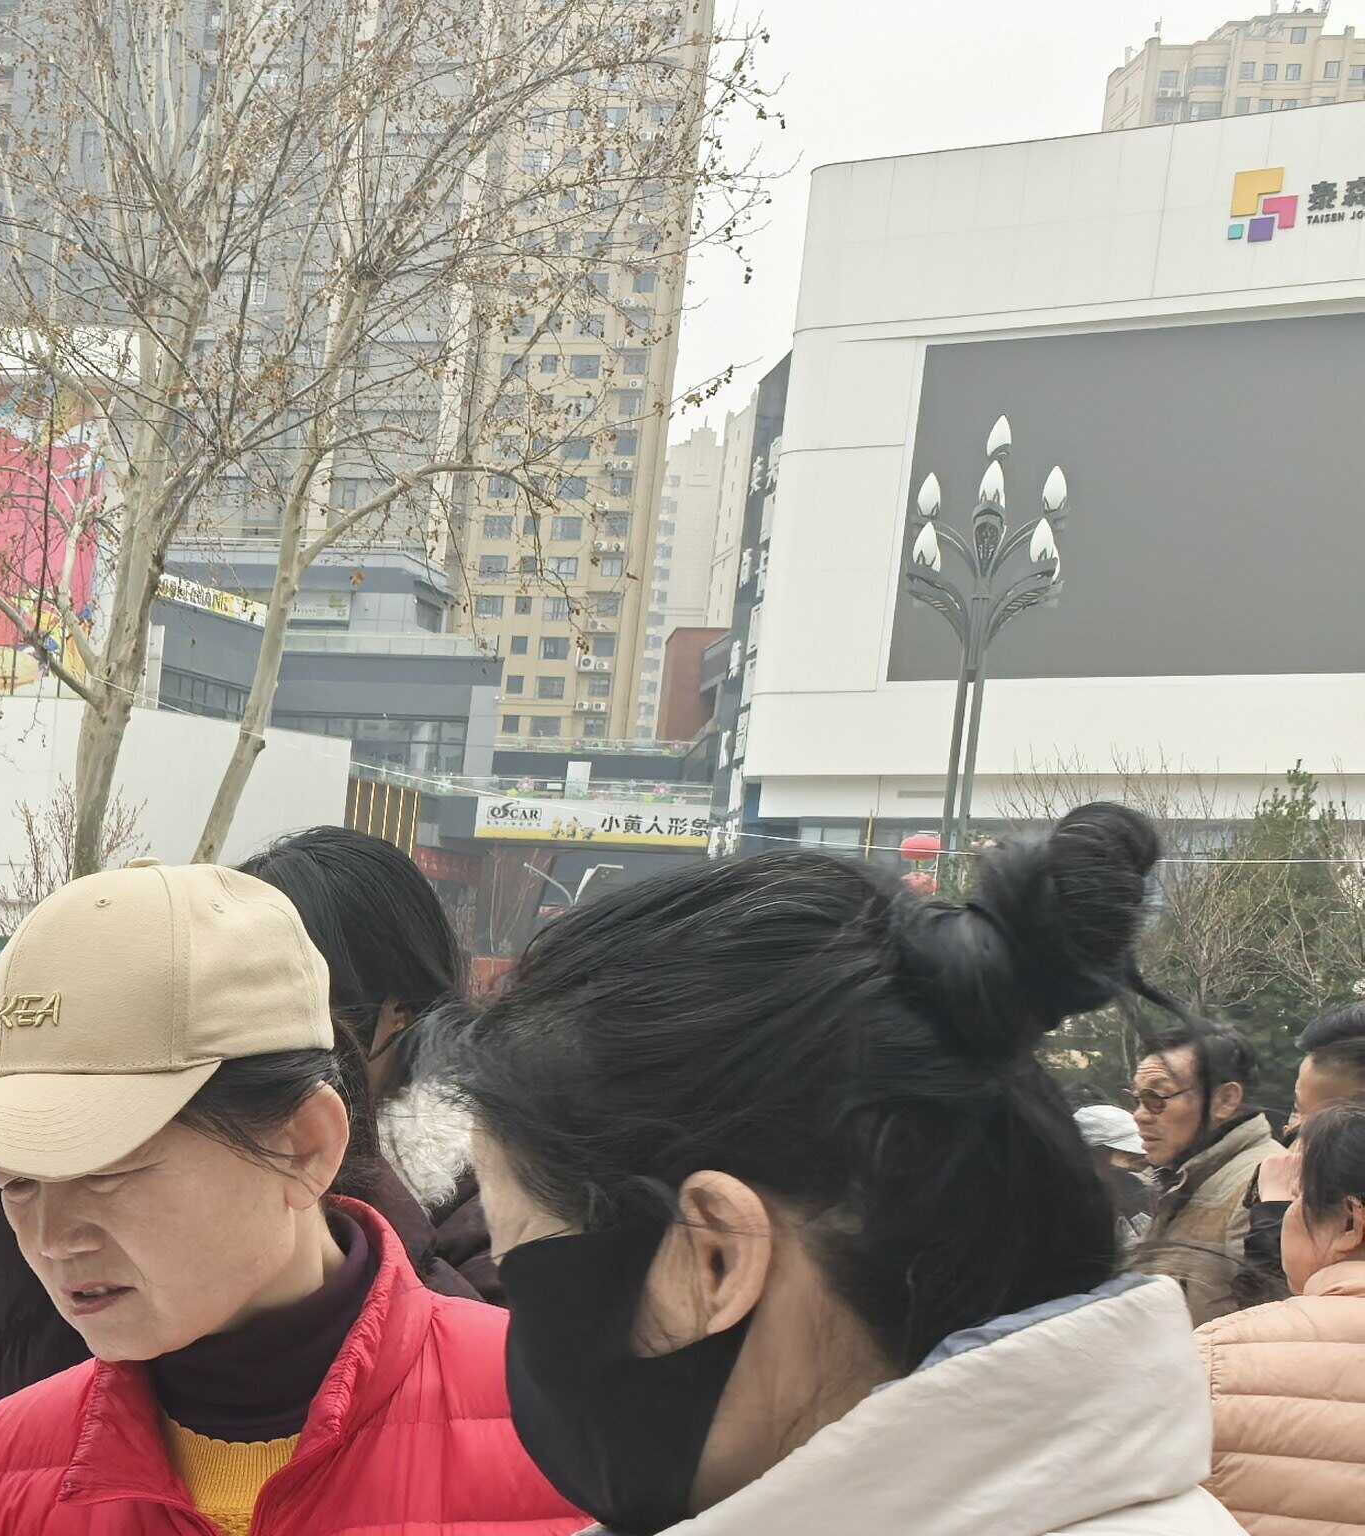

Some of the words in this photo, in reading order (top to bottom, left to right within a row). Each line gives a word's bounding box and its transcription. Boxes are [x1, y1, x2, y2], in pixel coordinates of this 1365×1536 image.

[1307, 211, 1345, 224] TAISEN
[489, 802, 541, 820] OSCAR
[601, 813, 710, 837] 小黄人形象
